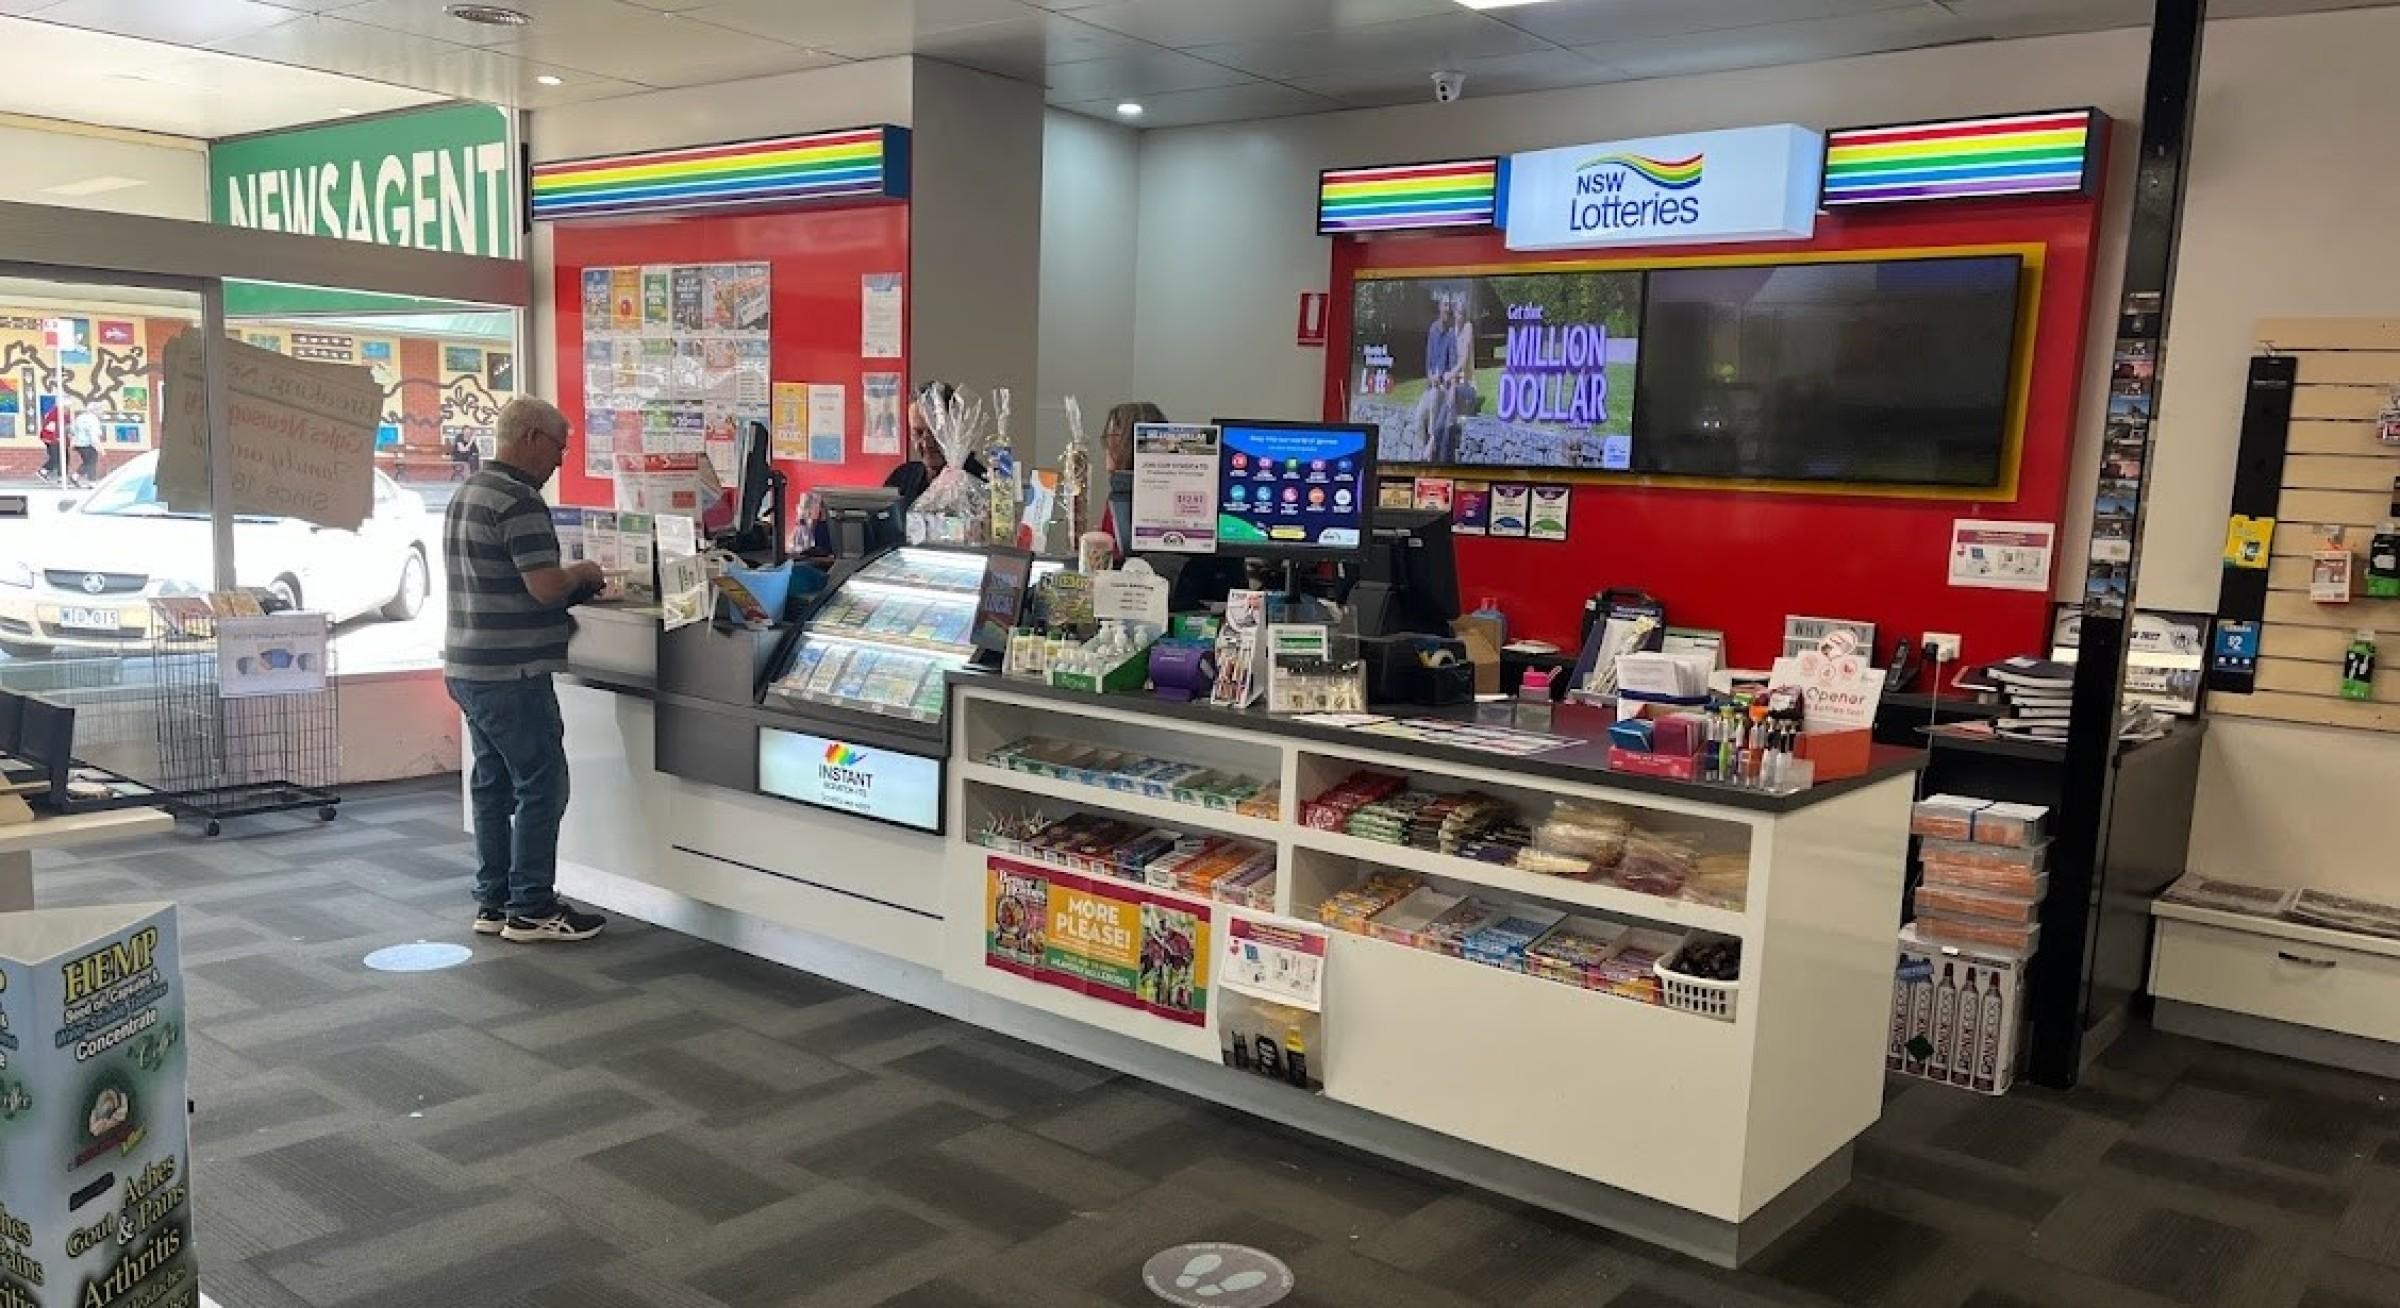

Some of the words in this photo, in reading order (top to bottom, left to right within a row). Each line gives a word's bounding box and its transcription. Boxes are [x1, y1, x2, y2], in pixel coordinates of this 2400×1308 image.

[227, 142, 507, 258] NEWSAGENT
[1576, 171, 1626, 196] NSW
[1568, 192, 1700, 232] Lotteries
[1505, 323, 1606, 369] MILLION
[1498, 372, 1608, 424] DOLLAR
[818, 764, 873, 789] INSTANT
[1055, 911, 1131, 950] PLEASE!
[1067, 896, 1120, 926] MORE
[62, 926, 158, 1006] HEMP
[75, 1007, 158, 1062] Concentrate
[126, 1155, 176, 1206] Aches
[67, 1212, 114, 1258] Gout
[117, 1211, 136, 1246] &
[138, 1183, 186, 1234] Pains
[84, 1227, 182, 1308] Arthritis
